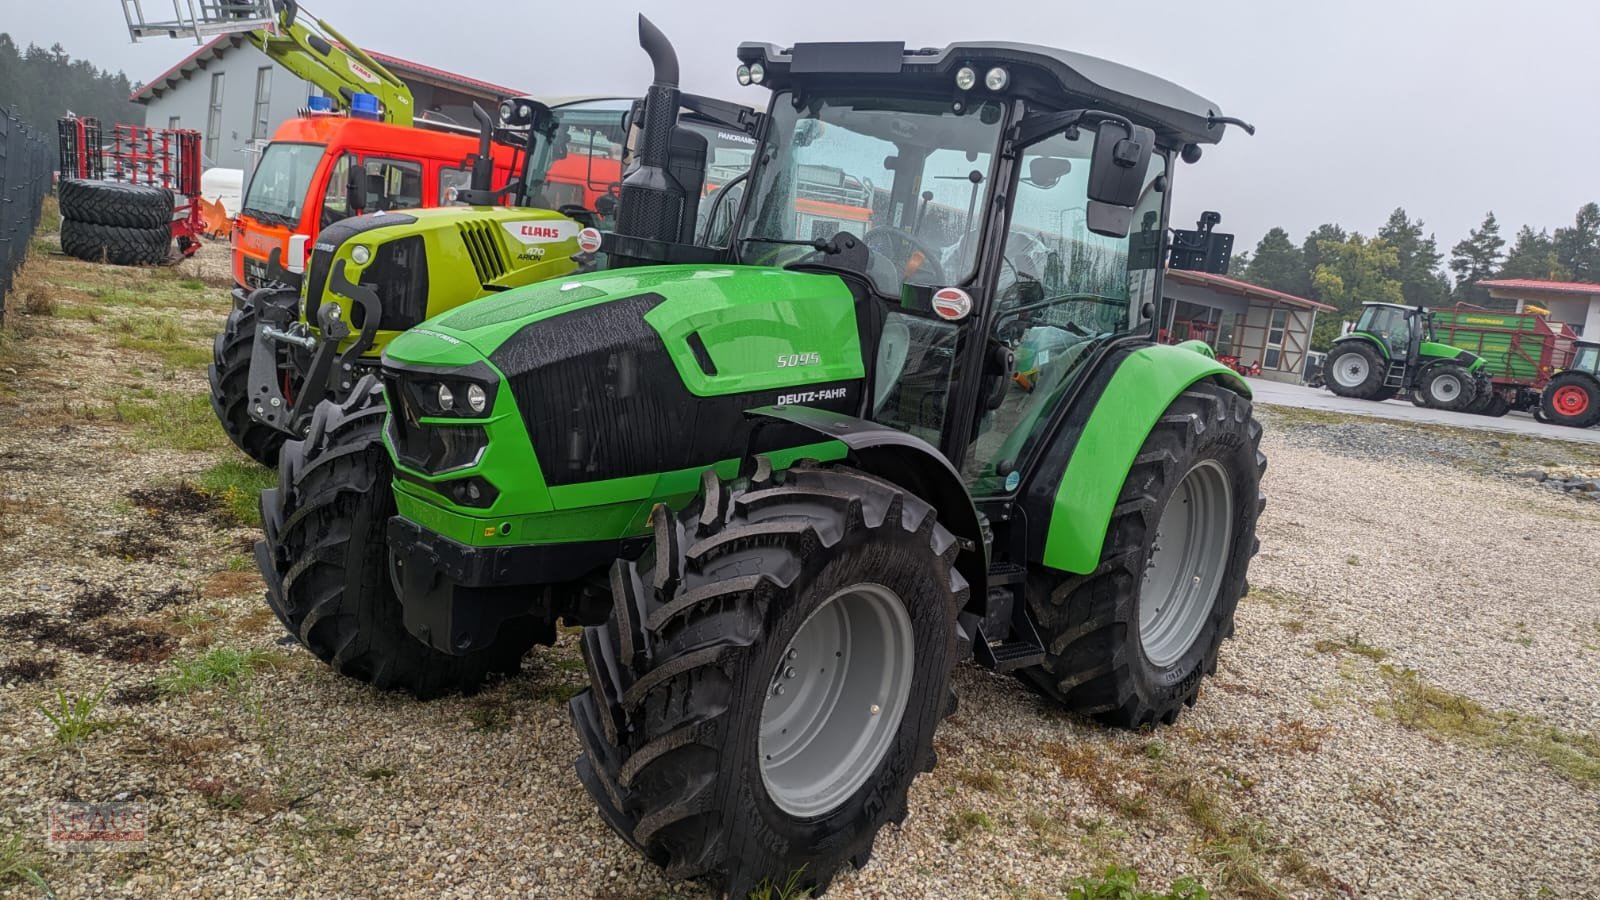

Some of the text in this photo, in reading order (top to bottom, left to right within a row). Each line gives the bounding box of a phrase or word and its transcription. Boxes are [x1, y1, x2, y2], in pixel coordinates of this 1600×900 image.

[351, 62, 372, 79] CLAAS
[521, 225, 559, 239] CLAAS
[517, 253, 542, 262] ARION
[527, 247, 545, 256] 470
[777, 351, 820, 368] 5095
[777, 387, 847, 406] DEUTZ-FAHR
